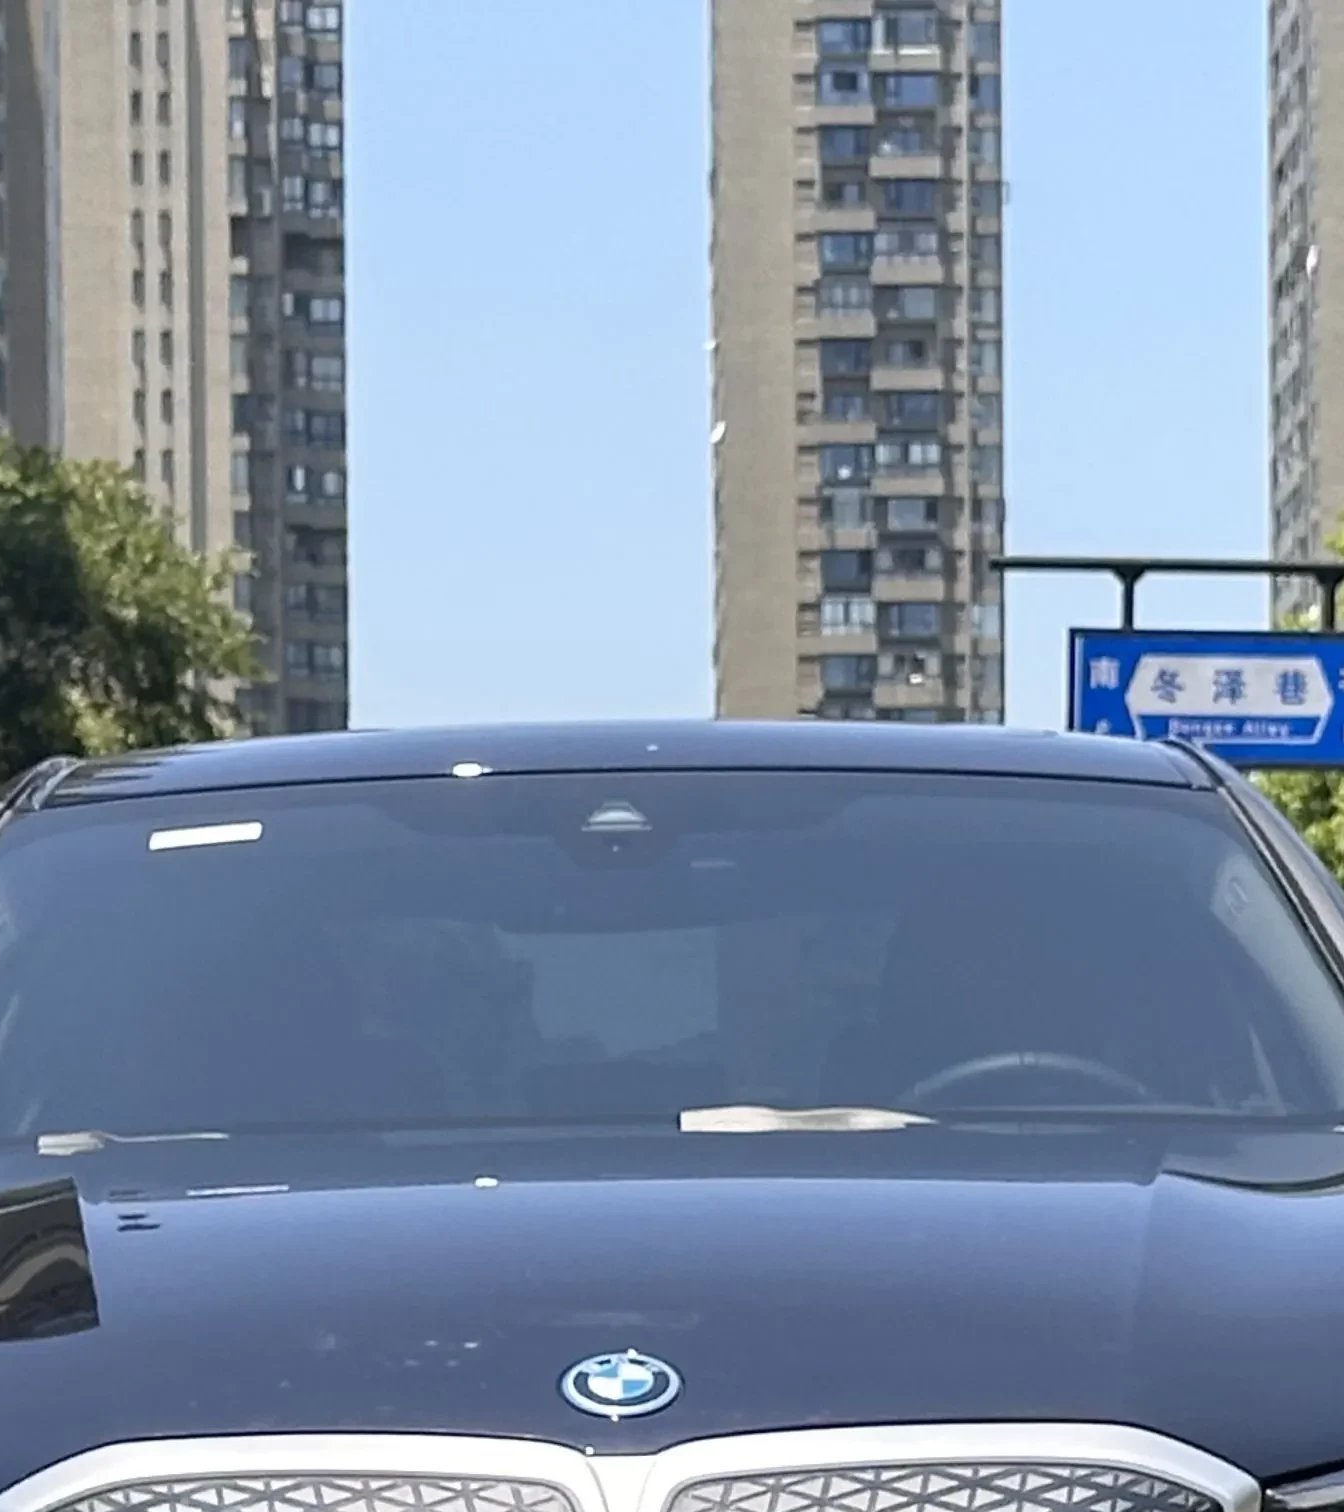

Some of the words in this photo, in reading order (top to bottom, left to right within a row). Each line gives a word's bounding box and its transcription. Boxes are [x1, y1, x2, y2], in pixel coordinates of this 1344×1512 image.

[1089, 656, 1120, 690] 南
[1150, 667, 1308, 705] 冬泽巷
